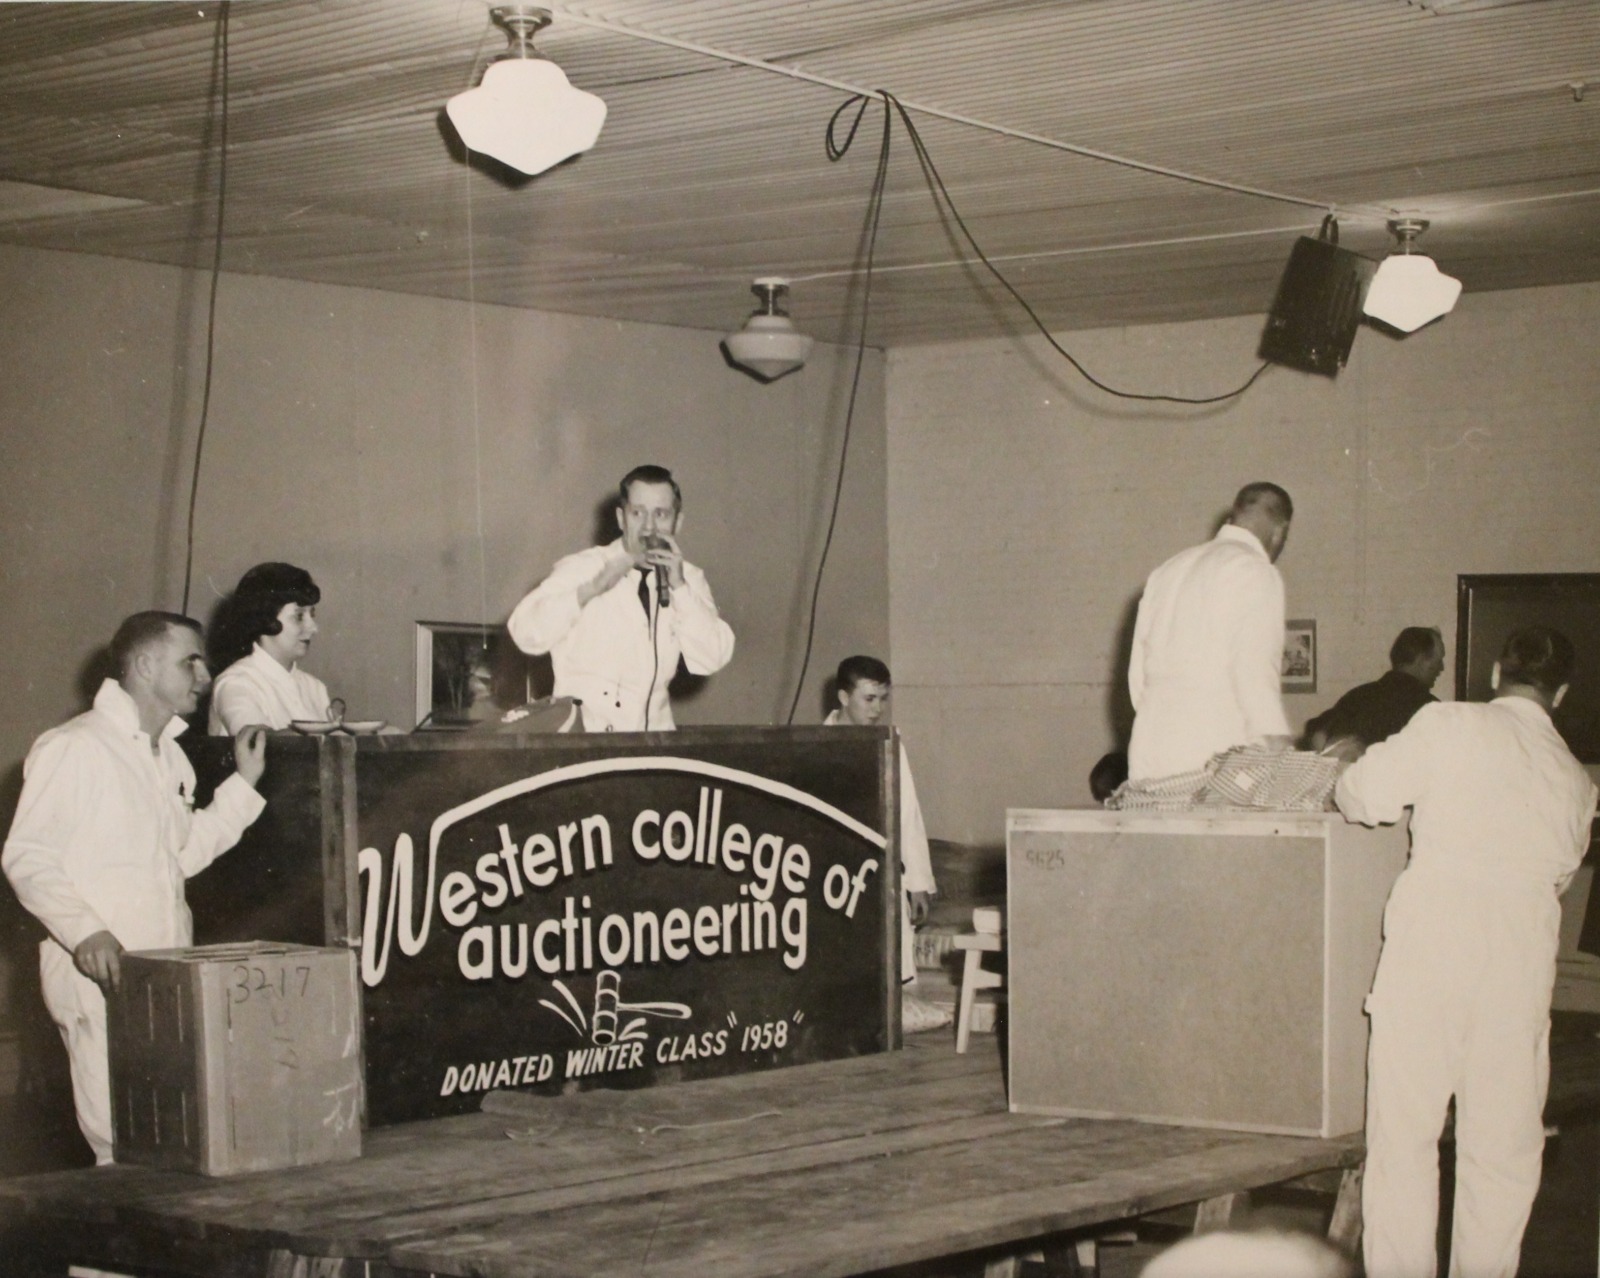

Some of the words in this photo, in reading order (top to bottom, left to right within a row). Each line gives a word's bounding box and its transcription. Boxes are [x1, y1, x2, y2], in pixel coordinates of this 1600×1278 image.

[358, 813, 614, 986] Western
[631, 787, 811, 900] college
[823, 858, 879, 919] of
[457, 896, 808, 981] auctioneering
[232, 965, 311, 1004] 3217
[440, 1053, 553, 1096] DONATED
[564, 1042, 644, 1078] WINTER
